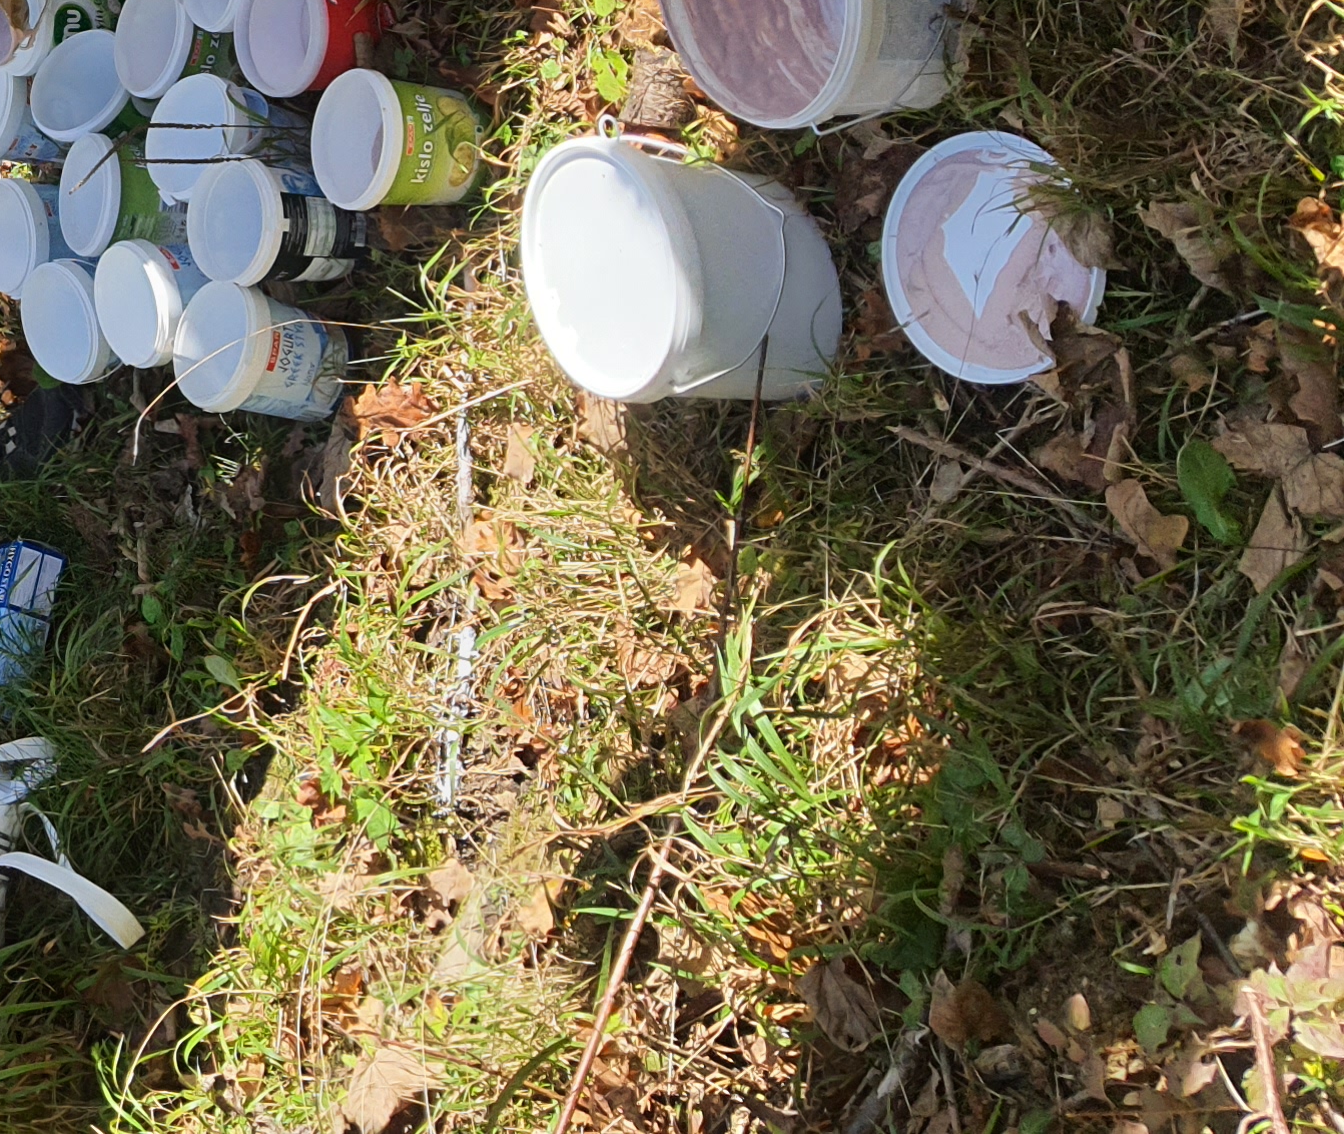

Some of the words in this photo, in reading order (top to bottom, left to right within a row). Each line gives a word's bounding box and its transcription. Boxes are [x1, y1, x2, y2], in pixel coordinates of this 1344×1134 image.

[415, 94, 433, 133] zelje
[410, 141, 433, 183] kislo
[278, 325, 294, 373] JOGURT
[284, 353, 302, 388] GREEK
